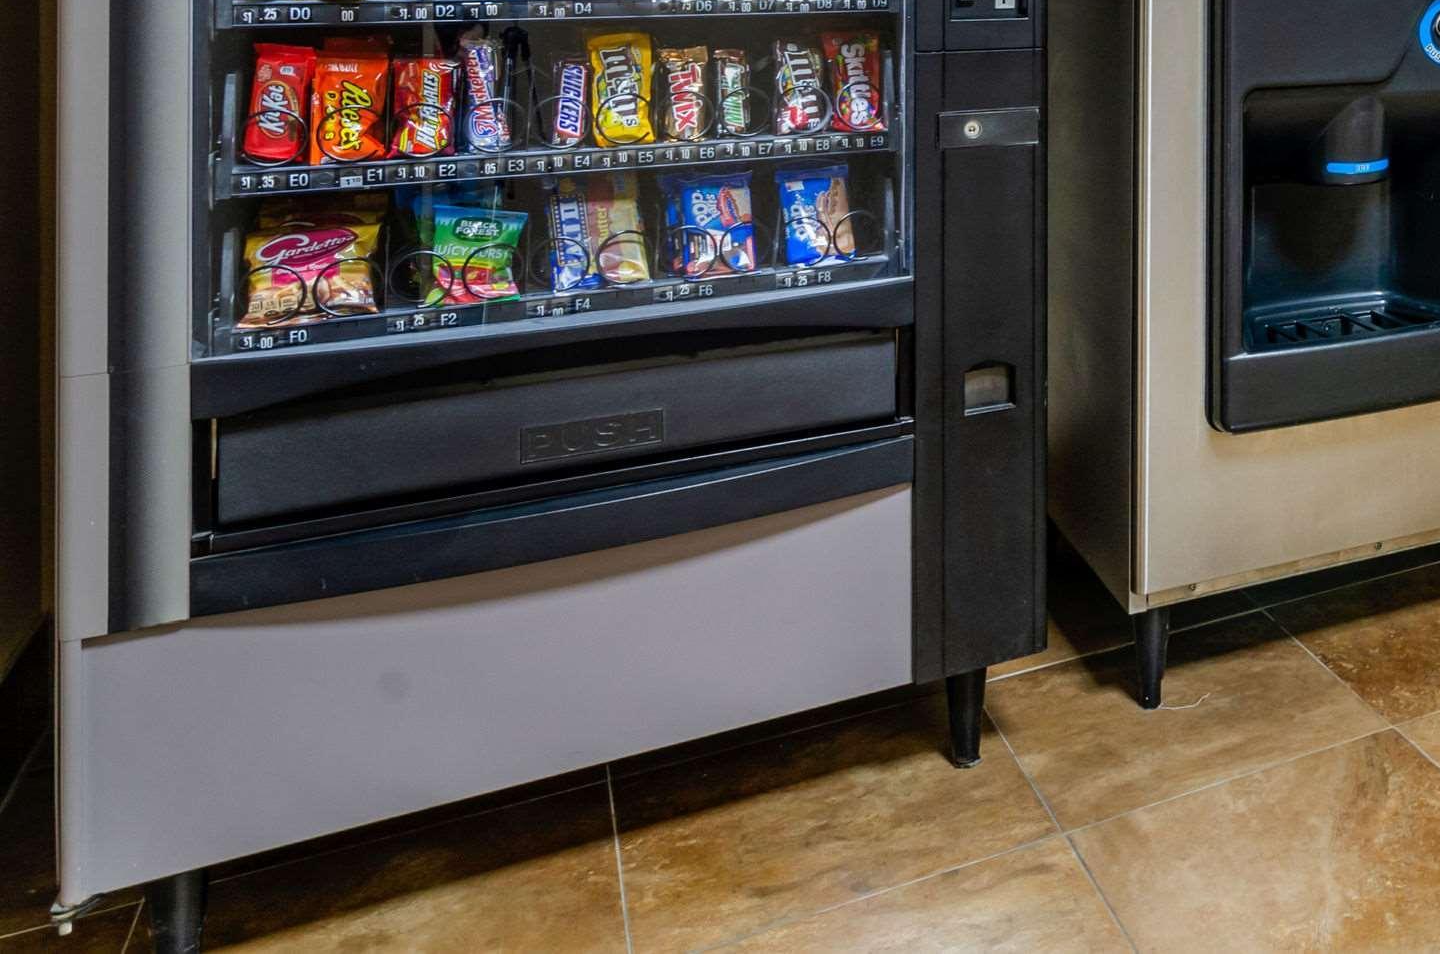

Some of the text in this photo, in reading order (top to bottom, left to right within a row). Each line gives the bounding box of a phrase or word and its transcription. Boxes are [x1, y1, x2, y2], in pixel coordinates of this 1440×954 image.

[435, 5, 455, 18] D2
[575, 2, 592, 15] D4
[696, 0, 712, 12] D6
[290, 7, 311, 21] D0
[559, 64, 585, 135] SNICKERS
[668, 63, 698, 133] TWIX
[758, 143, 773, 155] E7
[815, 140, 831, 151] E8
[638, 151, 654, 163] E5
[699, 147, 715, 159] E6
[507, 159, 524, 172] E3
[574, 155, 591, 167] E4
[367, 168, 384, 182] E1
[439, 163, 457, 177] E2
[289, 174, 309, 188] E0
[817, 271, 832, 283] F8
[698, 284, 714, 297] F6
[575, 298, 592, 311] F4
[440, 312, 458, 326] F2
[289, 329, 307, 343] F0
